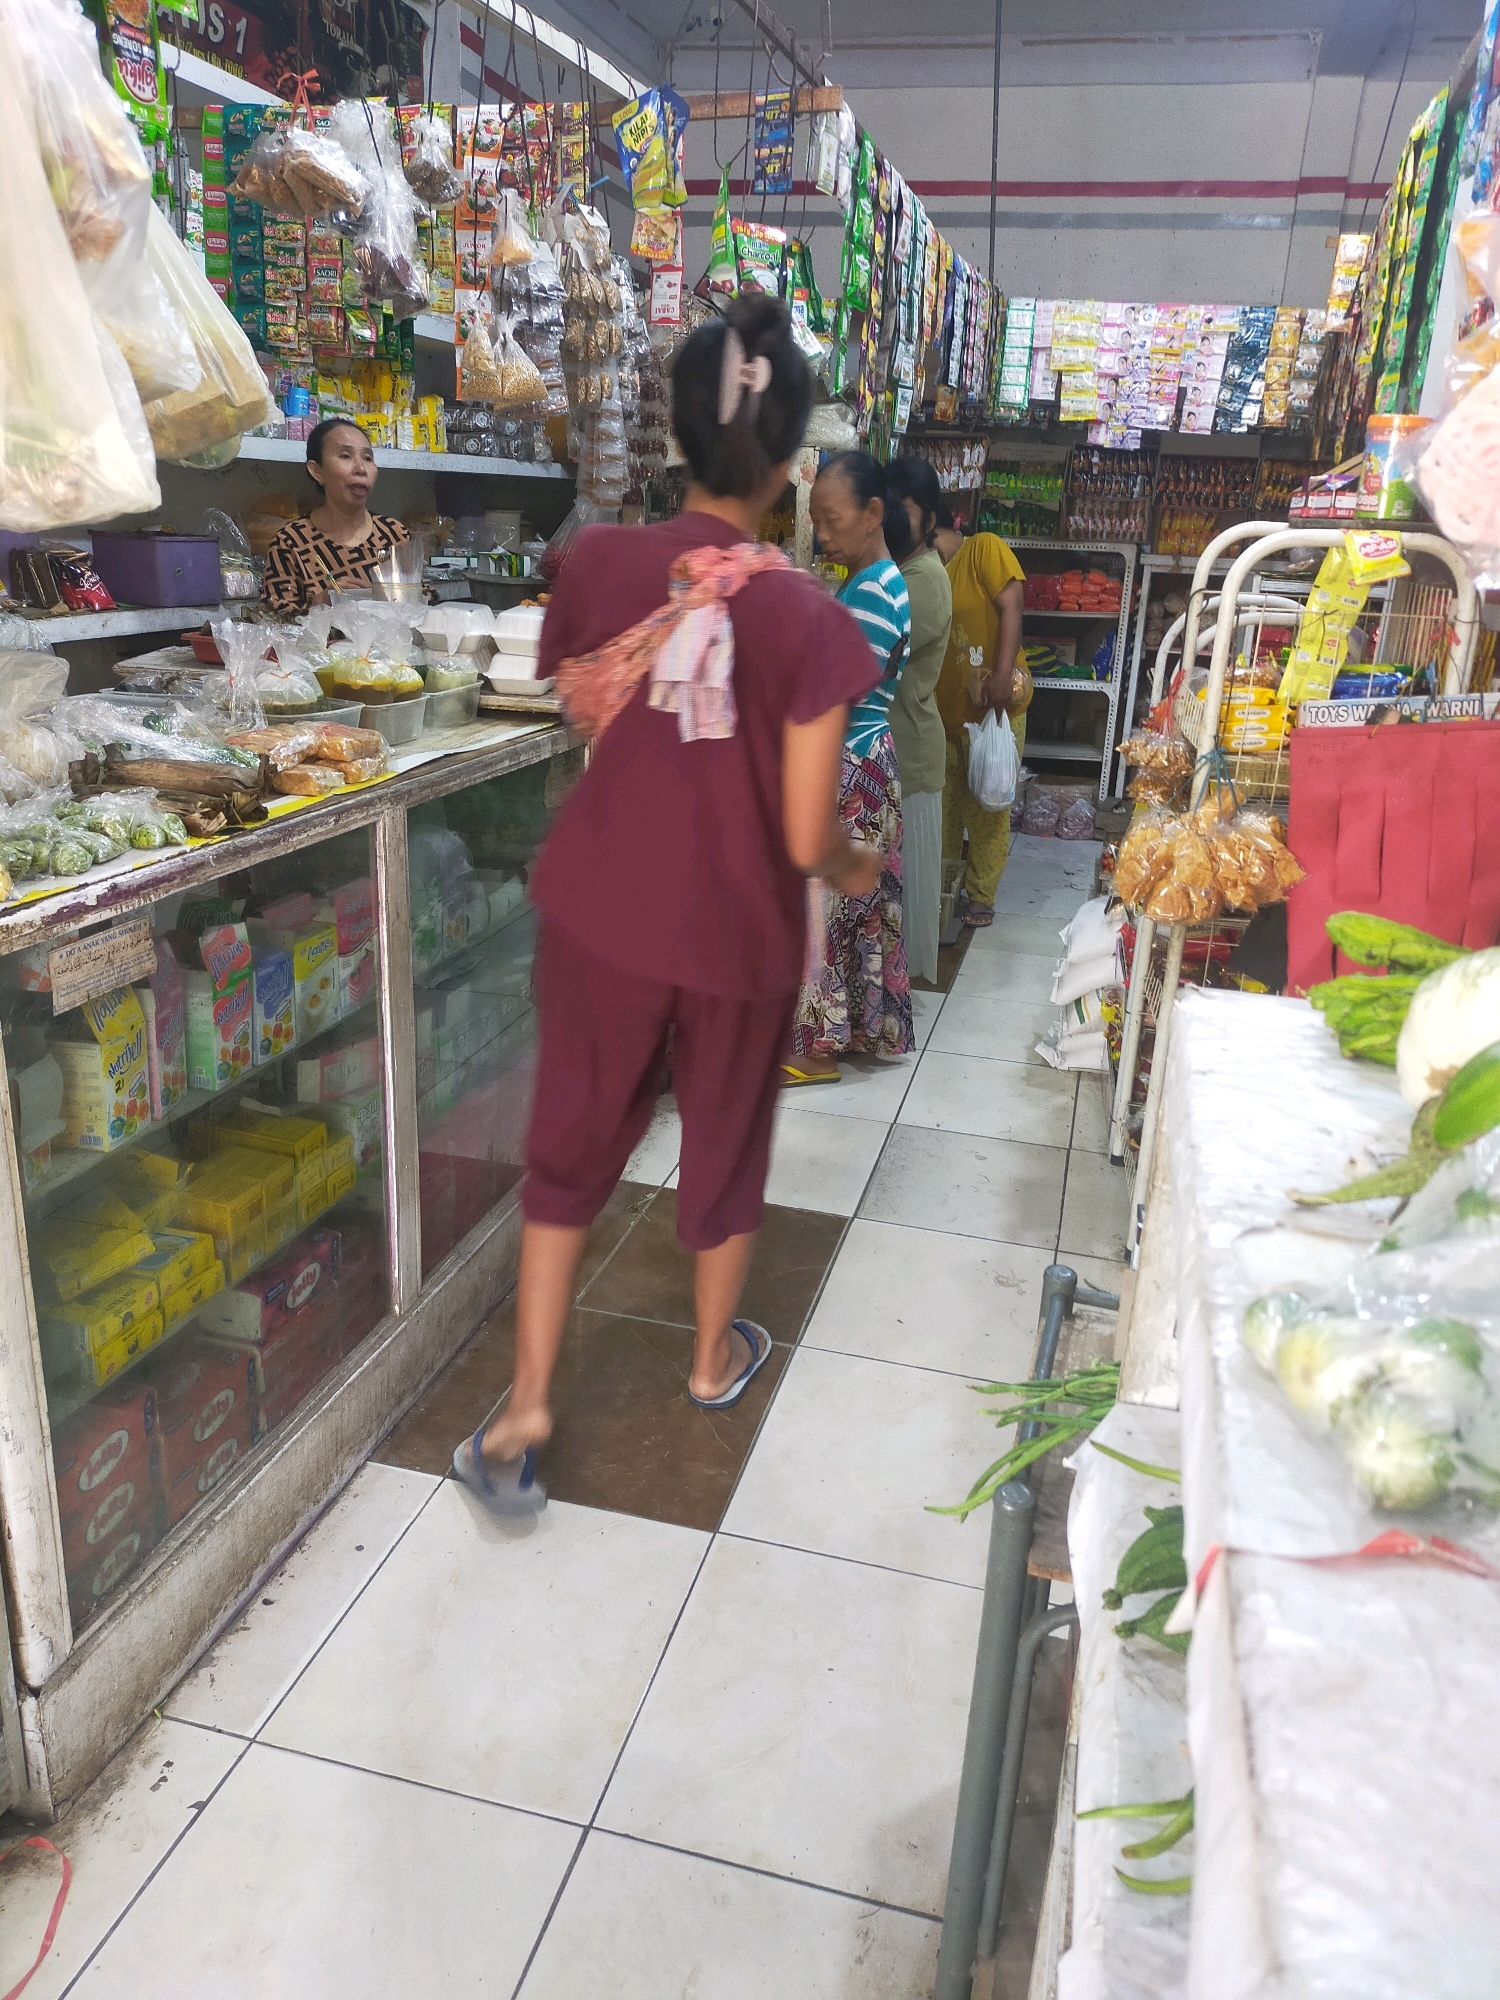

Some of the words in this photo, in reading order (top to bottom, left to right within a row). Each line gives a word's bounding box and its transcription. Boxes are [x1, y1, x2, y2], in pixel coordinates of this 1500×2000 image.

[236, 17, 247, 55] 1
[741, 246, 780, 262] Charcoal
[316, 269, 337, 278] SAORI
[1310, 705, 1349, 723] TOYS
[1427, 700, 1481, 717] WARNI
[82, 940, 100, 951] ANAK
[108, 1027, 142, 1080] Nutrijell
